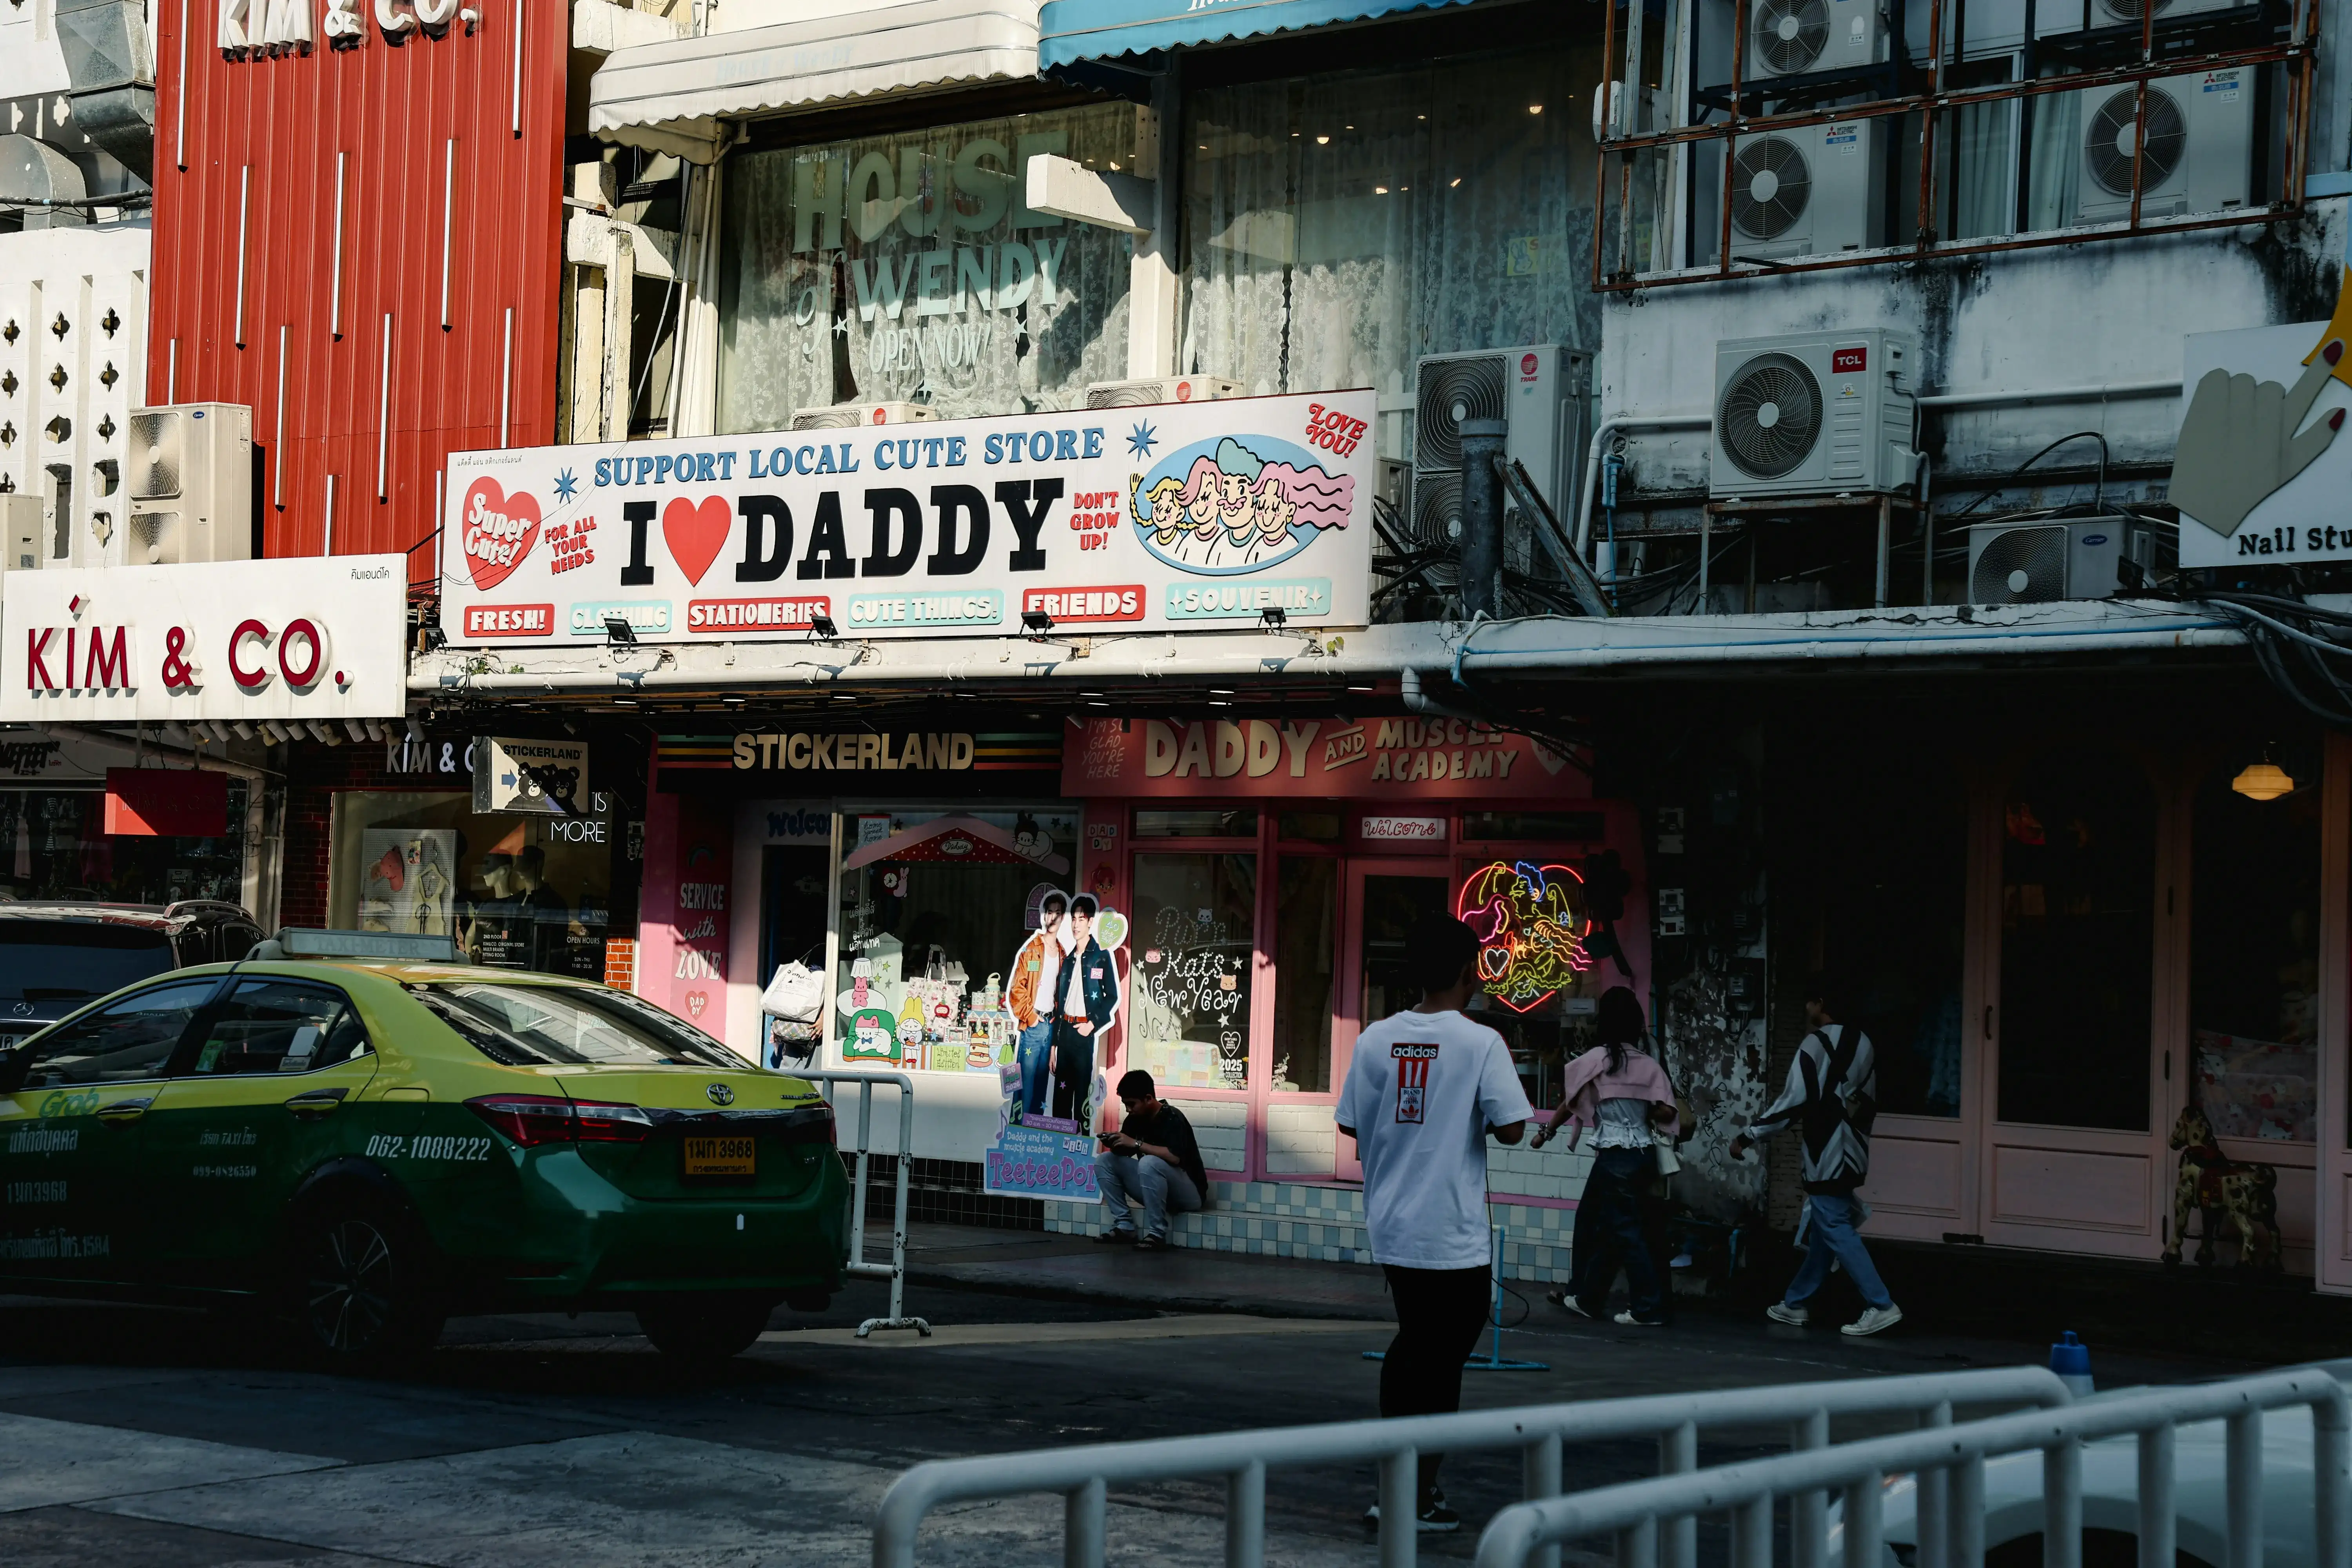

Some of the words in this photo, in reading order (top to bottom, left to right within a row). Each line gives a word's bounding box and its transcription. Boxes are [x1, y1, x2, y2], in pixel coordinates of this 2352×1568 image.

[796, 250, 848, 355] of
[851, 237, 1068, 322] WENDY
[869, 328, 927, 374] OPEN
[932, 322, 991, 368] NOW!
[1838, 356, 1862, 366] TCL
[1307, 403, 1368, 439] LOVE
[1305, 423, 1358, 459] YOU!
[595, 451, 738, 487] SUPPORT
[748, 443, 860, 478] LOCAL
[874, 436, 967, 470] CUTE
[984, 427, 1106, 464] STORE
[1074, 491, 1120, 510] DON'T
[468, 493, 532, 544] Super
[544, 524, 569, 544] FOR
[573, 515, 597, 535] ALL
[621, 501, 657, 586] I
[735, 477, 1064, 583] DADDY
[1070, 512, 1121, 531] GROW
[465, 527, 522, 568] Cute!
[552, 534, 588, 557] YOUR
[1080, 532, 1108, 550] UP!
[2238, 526, 2294, 555] Nail
[351, 566, 389, 580] คิมแอนด์โค
[550, 549, 595, 575] NEEDS
[850, 598, 906, 622] CUTE
[911, 595, 999, 621] THINGS!
[1028, 590, 1138, 619] FRIENDS
[1184, 586, 1308, 611] SOUVENIR
[470, 609, 546, 631] FRESH!
[570, 604, 668, 630] CLOTHING
[688, 601, 827, 628] STATIONERIES
[162, 626, 204, 689] &
[229, 618, 355, 689] CO.
[1088, 718, 1106, 735] I'M
[503, 744, 581, 760] STICKERLAND
[733, 732, 974, 770] STICKERLAND
[1090, 735, 1121, 750] GLAD
[1145, 720, 1321, 778] DADDY
[1324, 733, 1366, 763] AND
[439, 742, 456, 772] &
[1081, 747, 1125, 765] YOU'RE
[1372, 750, 1519, 782] ACADEMY
[1087, 764, 1120, 779] HERE
[551, 821, 606, 842] MORE
[767, 808, 831, 838] Welco
[864, 821, 882, 829] home
[680, 882, 724, 911] SERVICE
[684, 916, 716, 941] with
[675, 949, 723, 980] LOVE
[690, 996, 705, 1007] DAD
[1138, 972, 1187, 1009] New
[1187, 977, 1242, 1014] Year
[1393, 1045, 1437, 1058] adidas
[1006, 1065, 1016, 1075] 26
[1220, 1058, 1243, 1072] 2025
[1005, 1082, 1020, 1092] 2026
[40, 1088, 100, 1118] Grab
[221, 1132, 242, 1145] TAXI
[365, 1134, 491, 1161] 062-1088222
[719, 1140, 752, 1159] 3968
[1007, 1130, 1027, 1143] Daddy
[1028, 1133, 1040, 1143] and
[1041, 1133, 1053, 1143] the
[1026, 1144, 1054, 1156] academy
